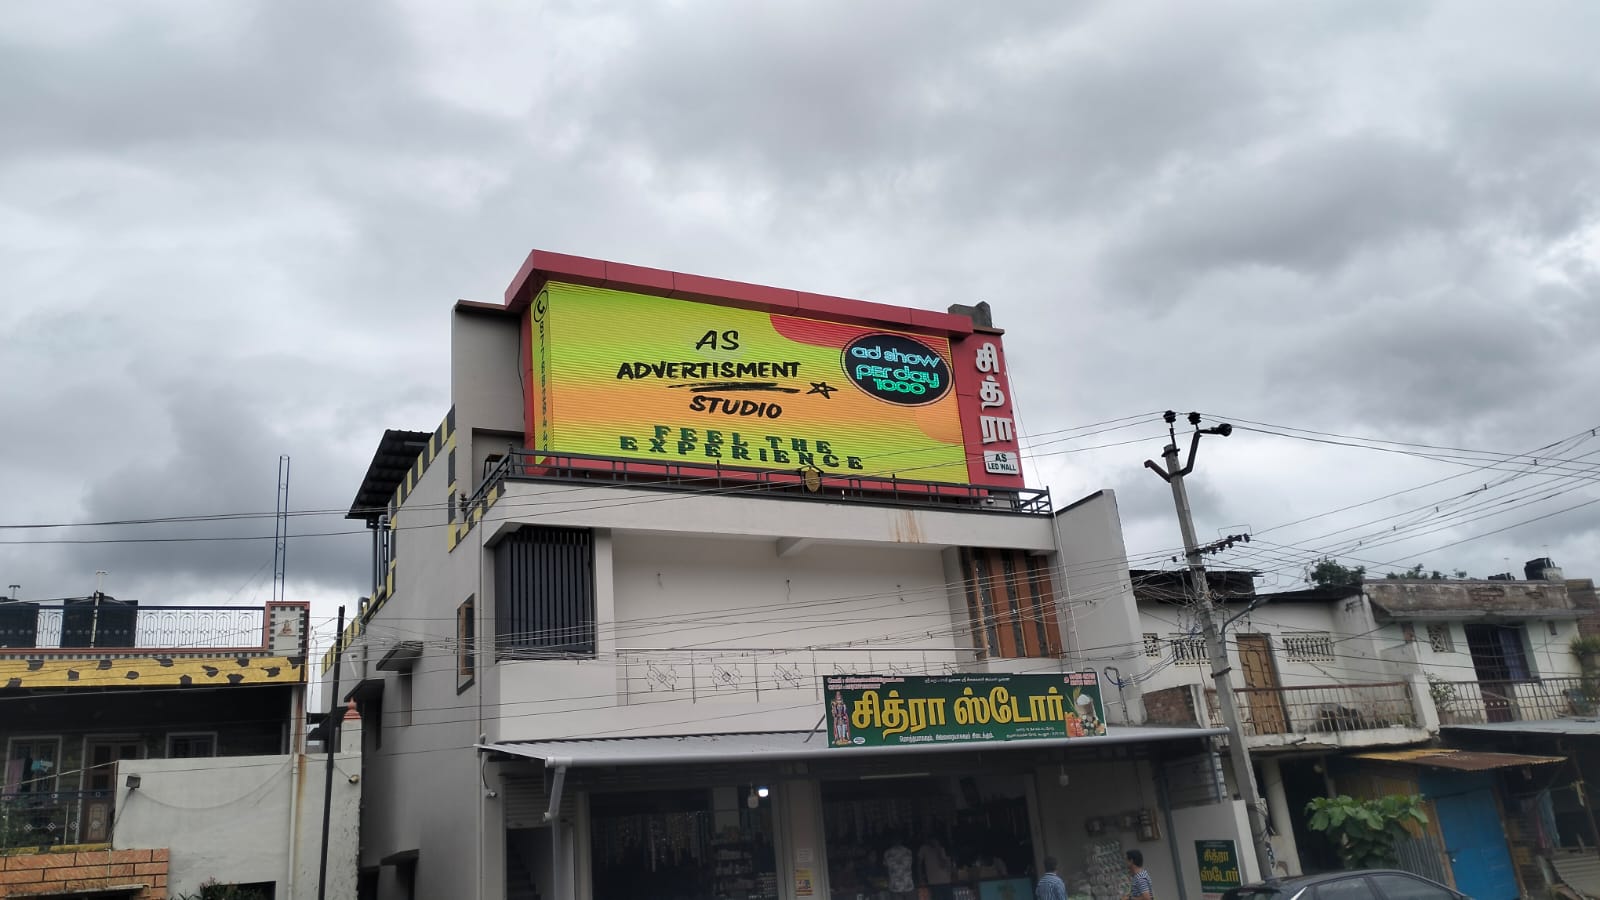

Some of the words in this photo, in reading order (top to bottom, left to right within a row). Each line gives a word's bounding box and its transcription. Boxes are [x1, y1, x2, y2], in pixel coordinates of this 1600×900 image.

[695, 329, 740, 351] AS
[851, 345, 882, 359] ad
[883, 347, 941, 368] show
[616, 361, 801, 380] ADVERTISMENT
[875, 377, 927, 396] 1000
[975, 342, 1014, 444] சித்ரா
[689, 394, 783, 419] STUDIO
[653, 424, 750, 446] FEEL
[765, 434, 833, 455] THE
[619, 435, 865, 471] EXPERIENCE
[994, 453, 1008, 463] AS
[987, 462, 1001, 471] LED
[1000, 462, 1017, 472] WALL
[851, 689, 946, 740] சித்ரா
[953, 686, 1065, 725] ஸ்டோர்
